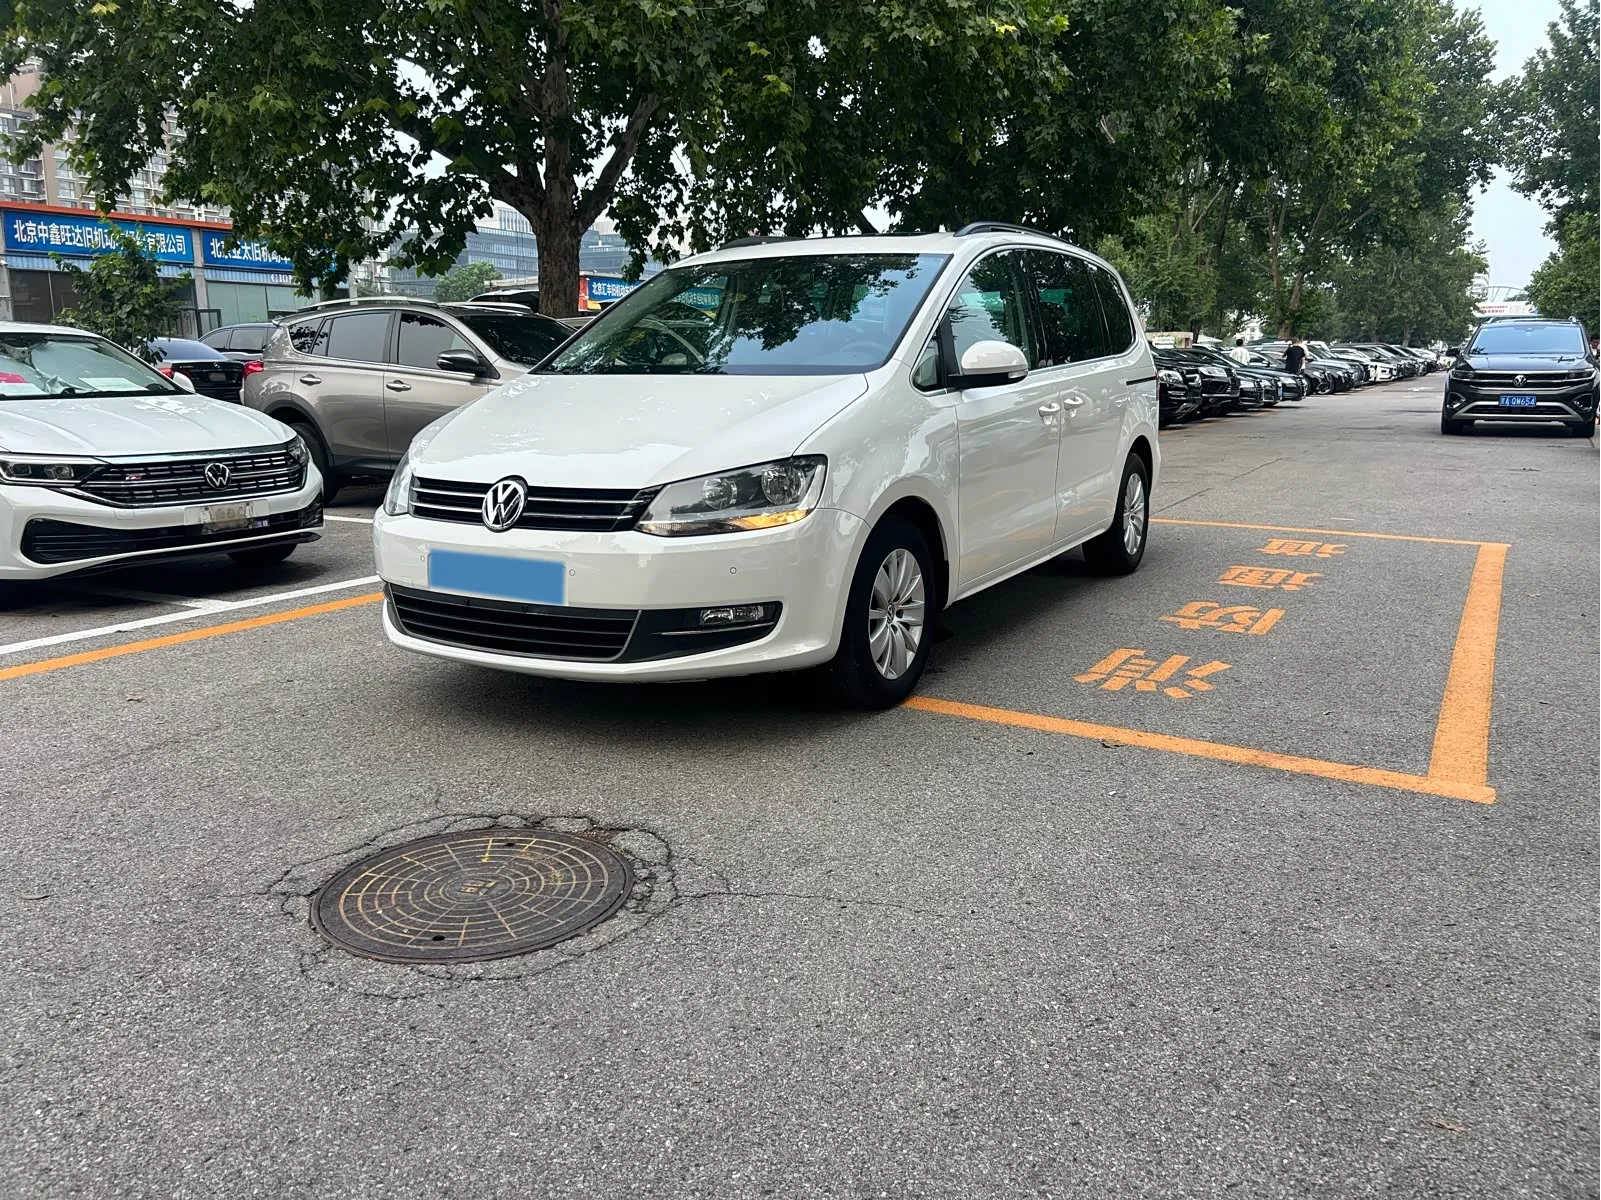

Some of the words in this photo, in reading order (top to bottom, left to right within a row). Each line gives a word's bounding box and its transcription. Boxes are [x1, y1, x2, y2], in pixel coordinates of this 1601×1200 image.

[13, 219, 186, 255] 北京中鑫旺达旧机动纪有限公司
